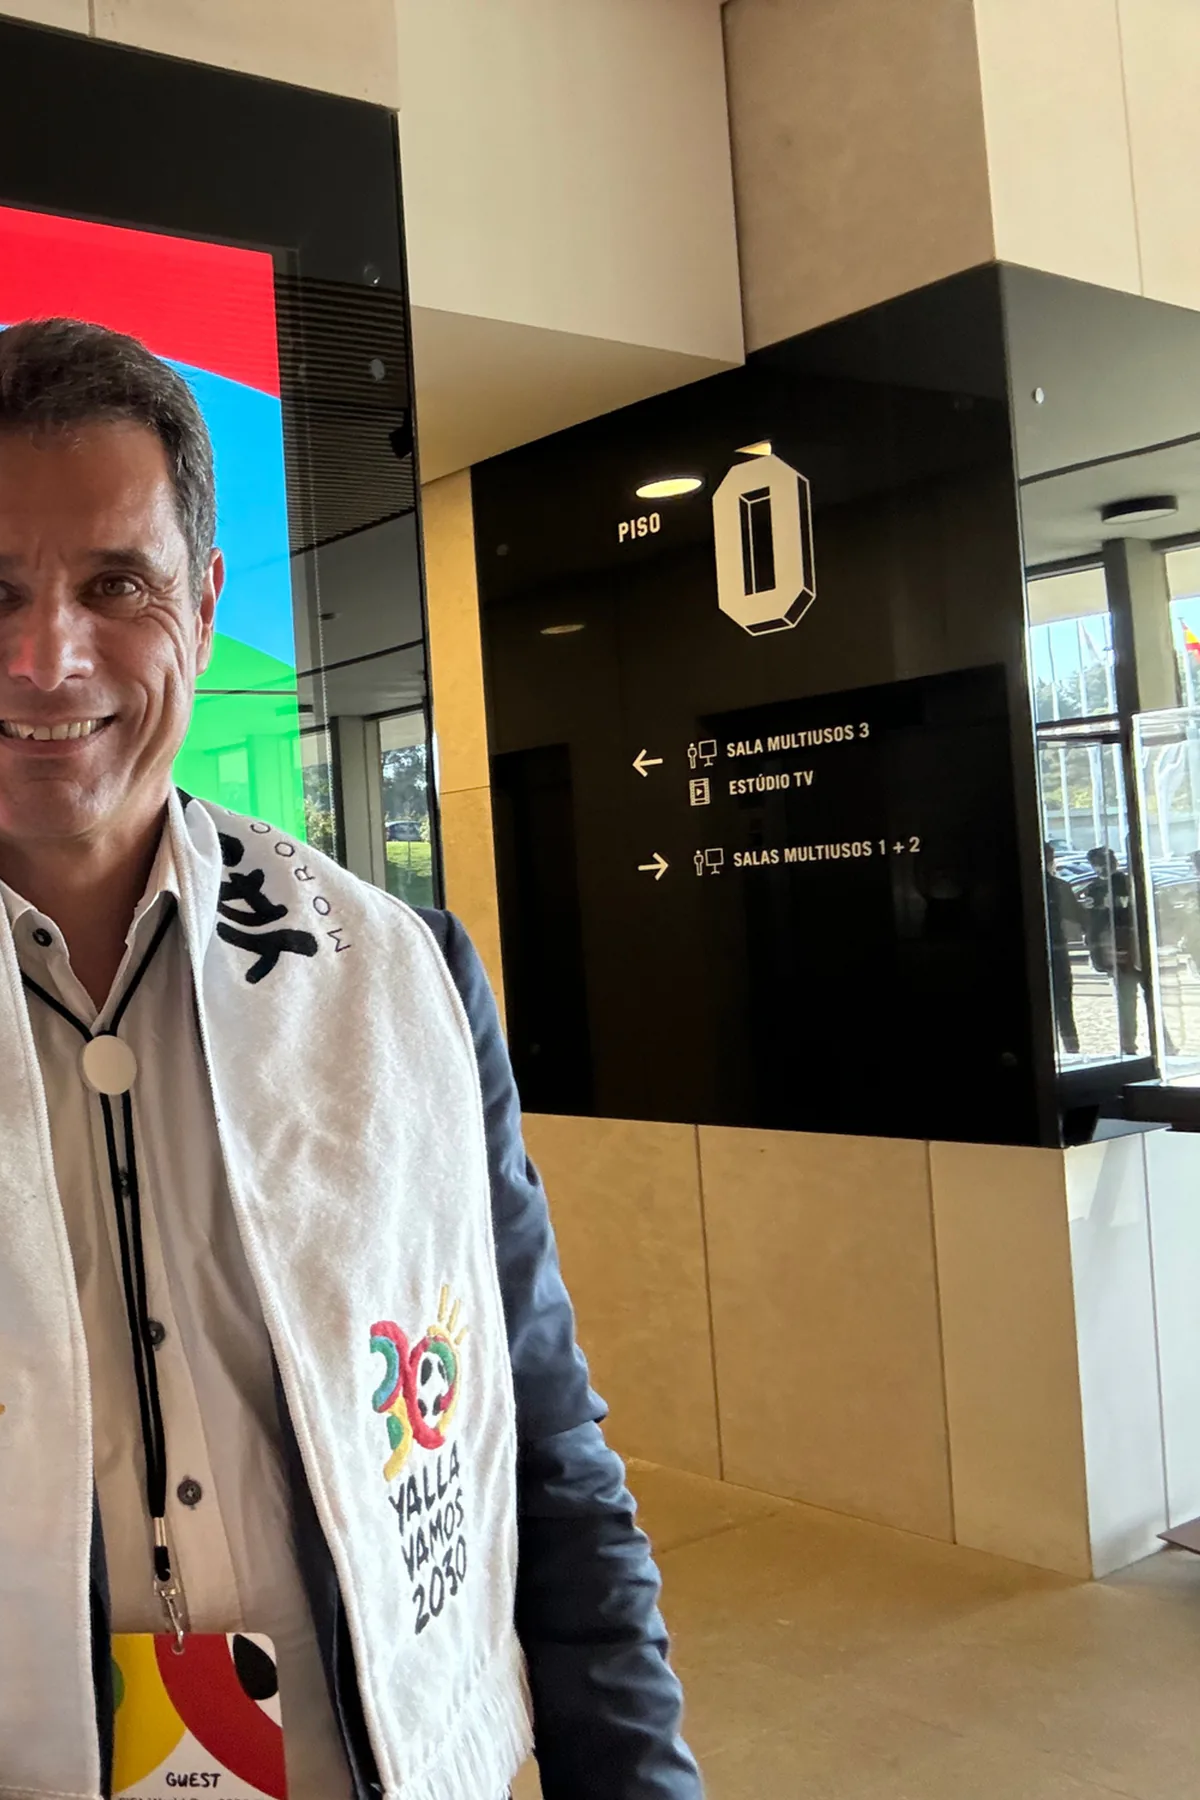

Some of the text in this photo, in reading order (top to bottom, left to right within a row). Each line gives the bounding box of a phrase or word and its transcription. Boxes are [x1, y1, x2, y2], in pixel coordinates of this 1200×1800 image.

[617, 511, 661, 543] PISO
[711, 453, 817, 637] 0
[726, 722, 871, 758] SALA MULTIUSOS 3
[728, 769, 814, 795] ESTÚDIO TV
[733, 836, 921, 868] SALAS MULTIUSOS 1 + 2
[388, 1440, 460, 1537] YALLA
[401, 1487, 465, 1583] VAMOS
[412, 1534, 468, 1636] 2030
[165, 1771, 222, 1788] GUEST
